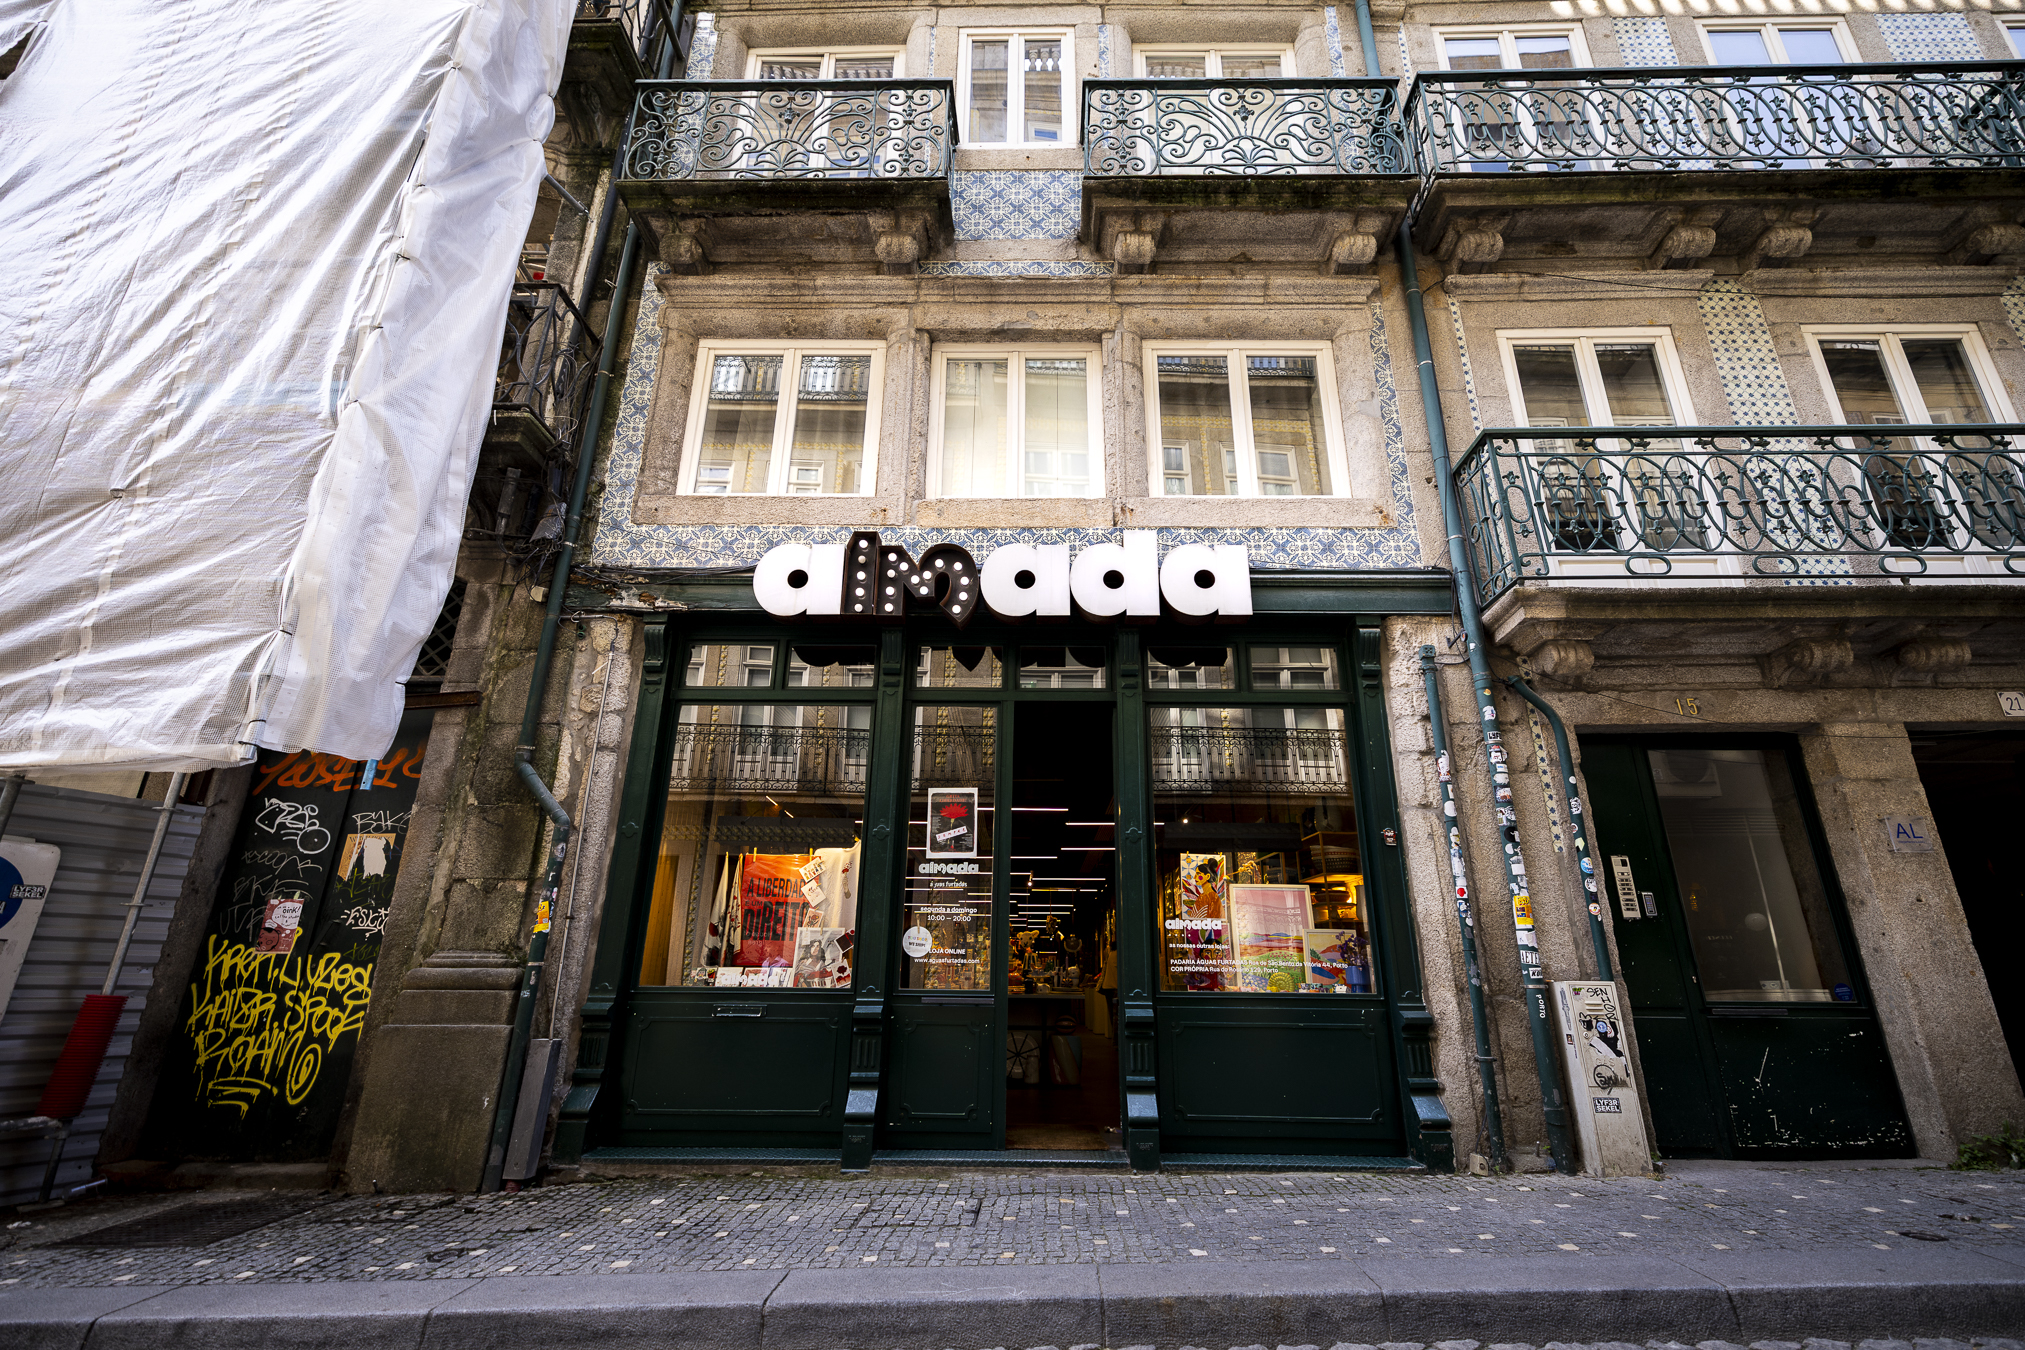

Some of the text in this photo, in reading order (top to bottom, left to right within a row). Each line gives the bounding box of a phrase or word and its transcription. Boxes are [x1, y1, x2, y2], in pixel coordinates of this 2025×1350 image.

[753, 529, 1253, 630] almada
[1676, 698, 1698, 715] 15
[2006, 697, 2024, 711] 21
[1897, 823, 1924, 839] AL
[918, 861, 980, 875] almada
[746, 877, 806, 898] A LIBERDAD
[951, 906, 978, 914] domingo
[742, 901, 810, 941] DIREITO
[1165, 918, 1222, 930] almada
[721, 973, 780, 986] almada
[1535, 994, 1546, 1019] PORTO
